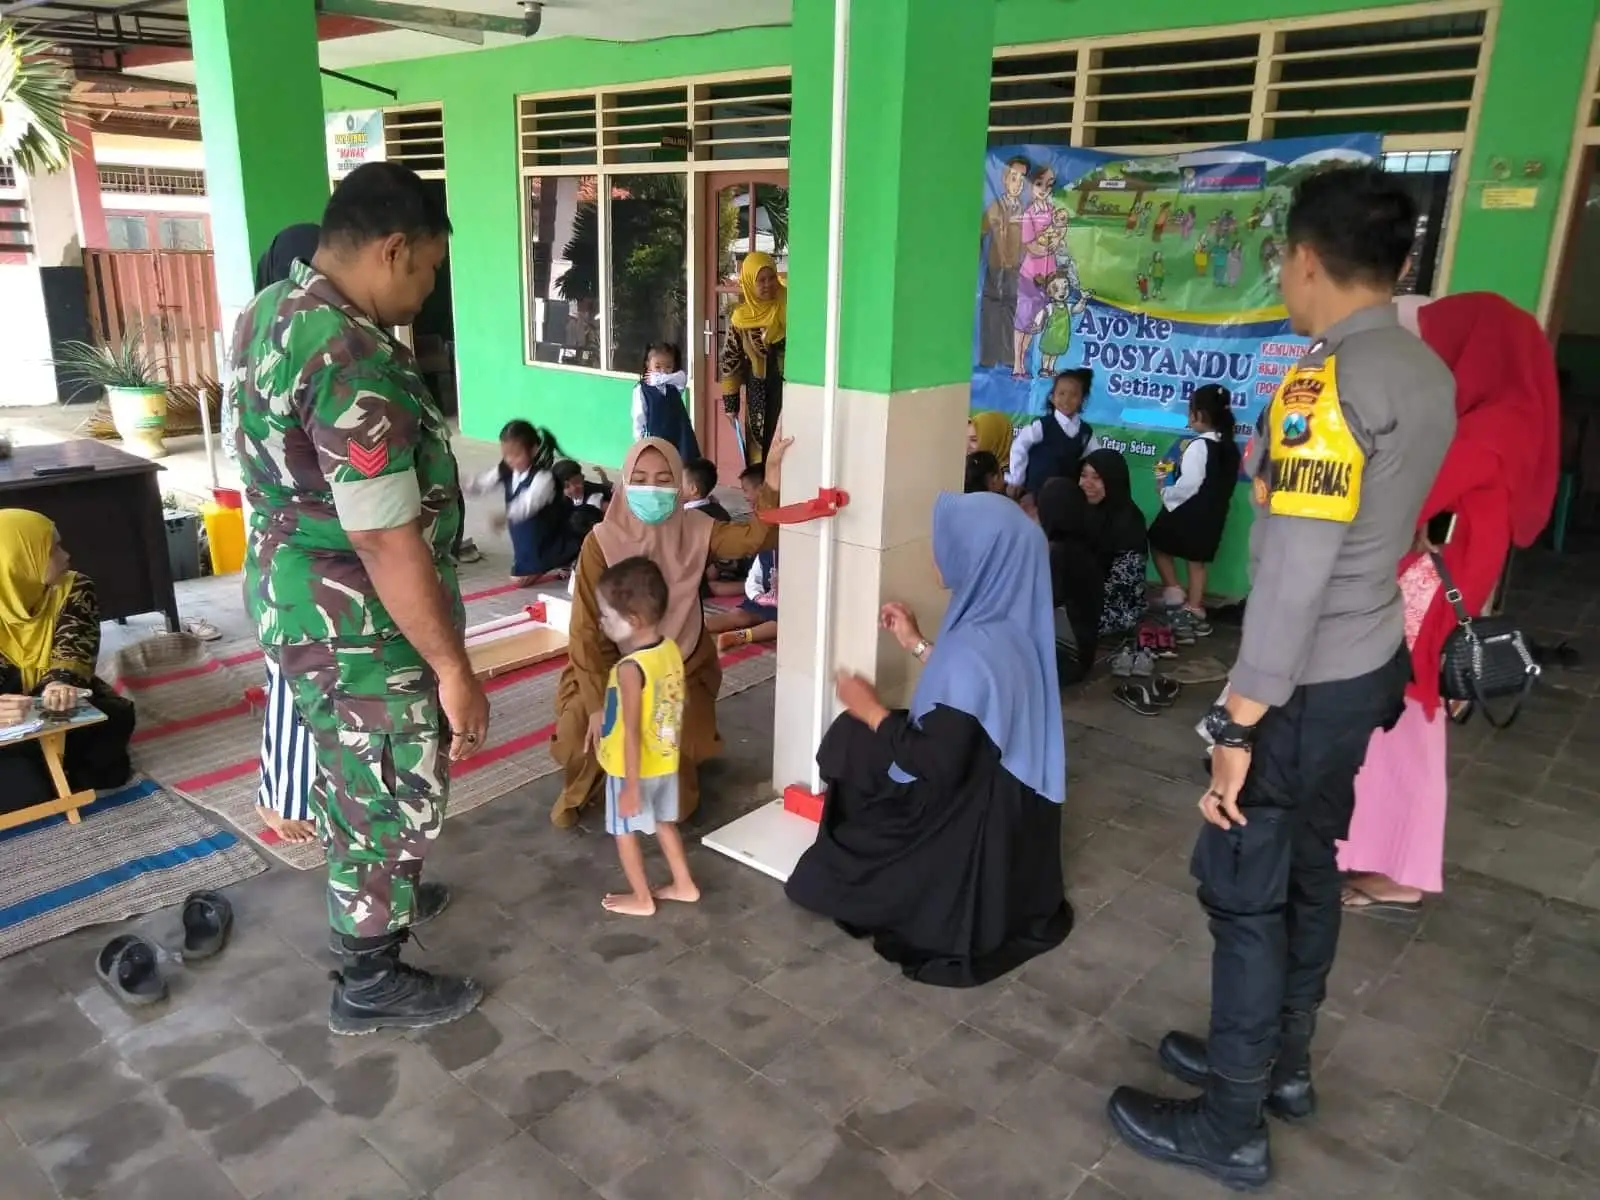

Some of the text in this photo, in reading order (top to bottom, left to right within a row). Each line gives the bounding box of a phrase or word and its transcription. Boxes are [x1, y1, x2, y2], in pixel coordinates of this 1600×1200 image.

[1075, 310, 1172, 340] Ayo ke
[1081, 341, 1254, 381] POSYANDU
[1107, 373, 1175, 403] Setiap
[1102, 436, 1156, 456] Tetap Sehat
